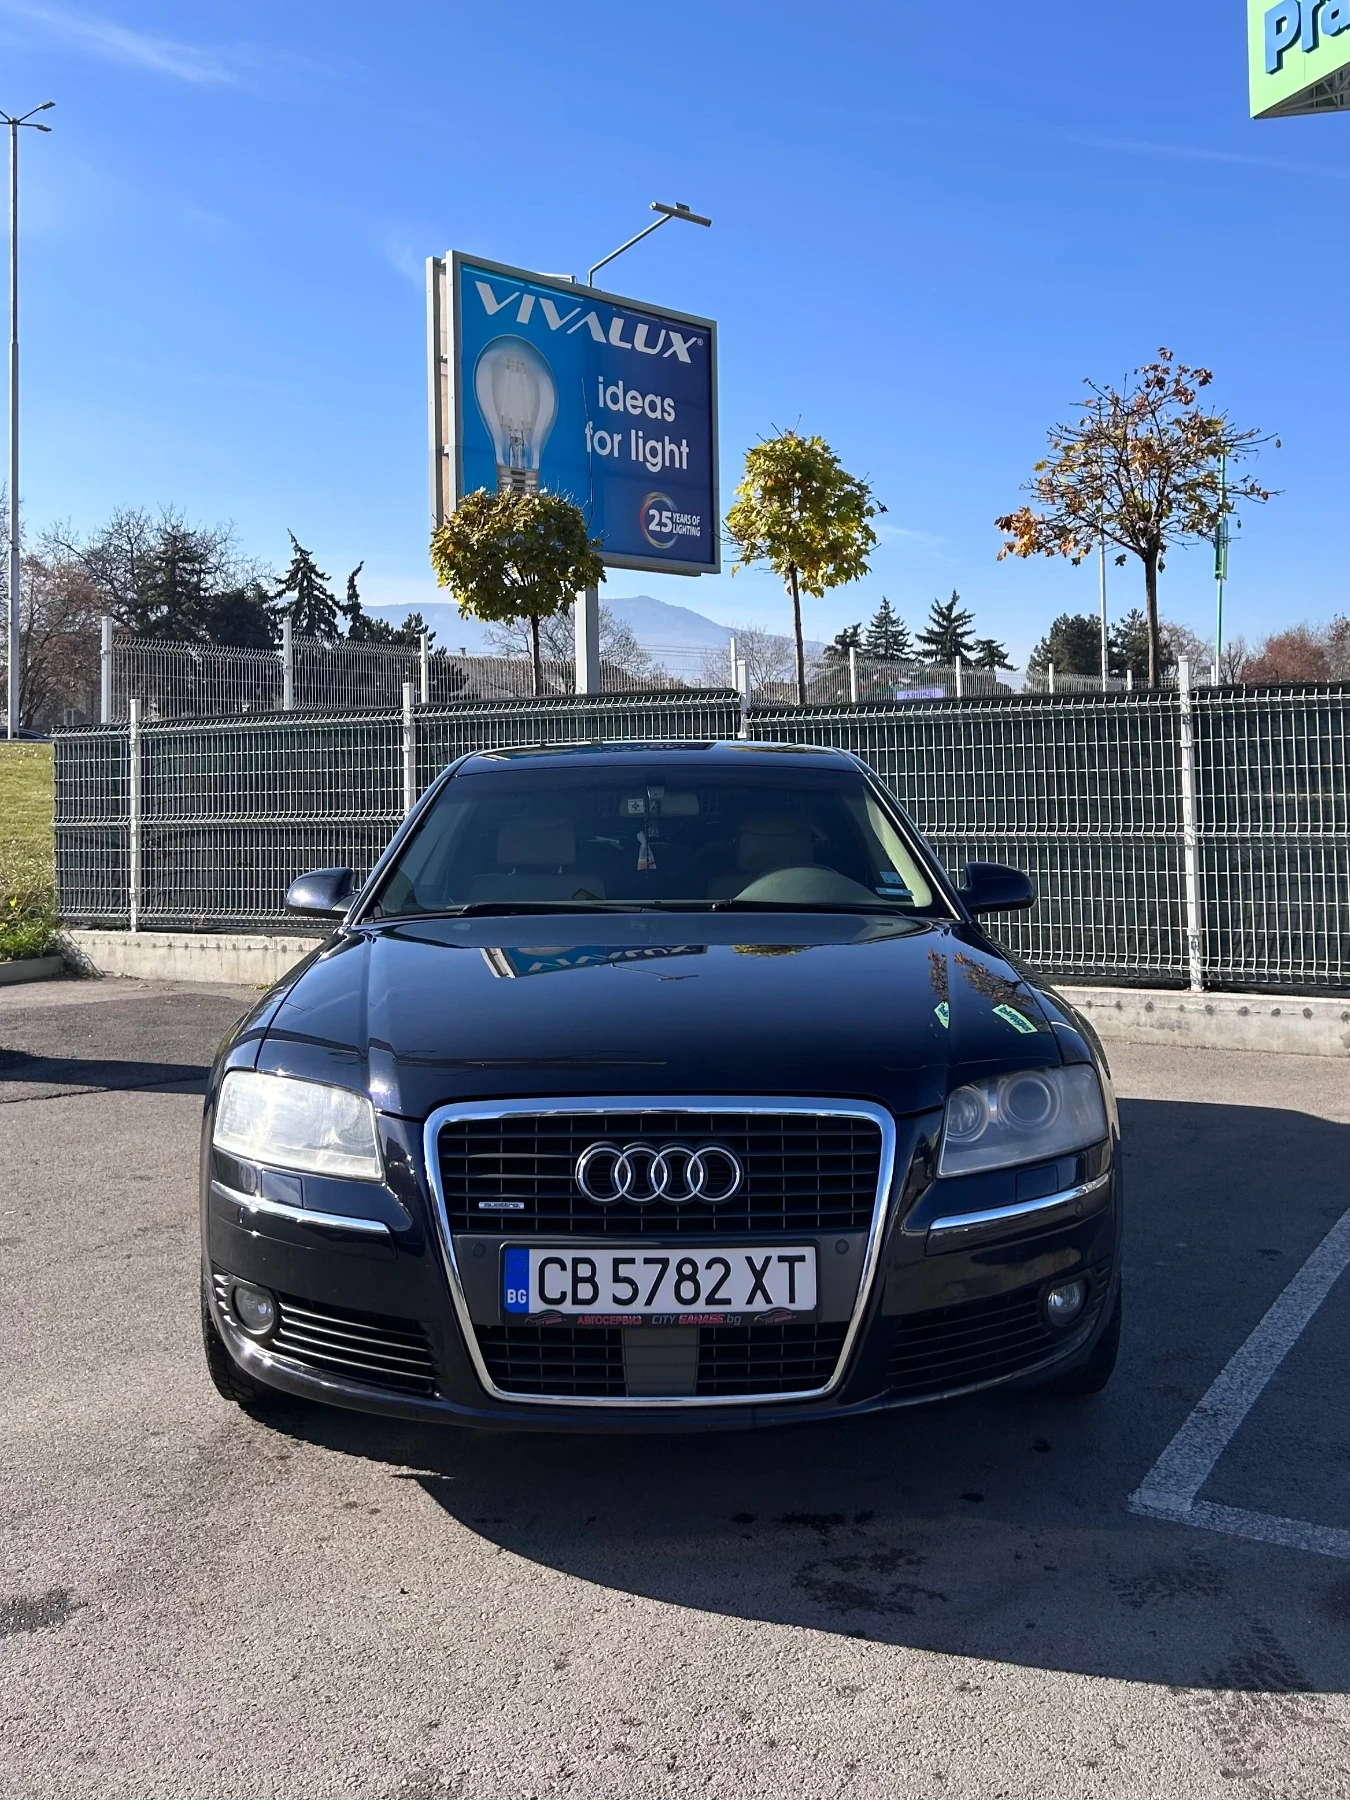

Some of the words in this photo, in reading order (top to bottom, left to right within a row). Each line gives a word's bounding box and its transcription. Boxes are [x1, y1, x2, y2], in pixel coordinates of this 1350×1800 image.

[598, 376, 676, 422] ideas
[585, 420, 622, 457] for
[631, 429, 690, 473] light
[648, 508, 673, 533] 25
[672, 512, 691, 525] YEARS
[691, 515, 701, 526] OF
[672, 524, 701, 537] LIGHTING
[507, 1289, 527, 1304] BG
[576, 1315, 642, 1325] АВТОСЕРВИЗ
[652, 1314, 676, 1325] CITY
